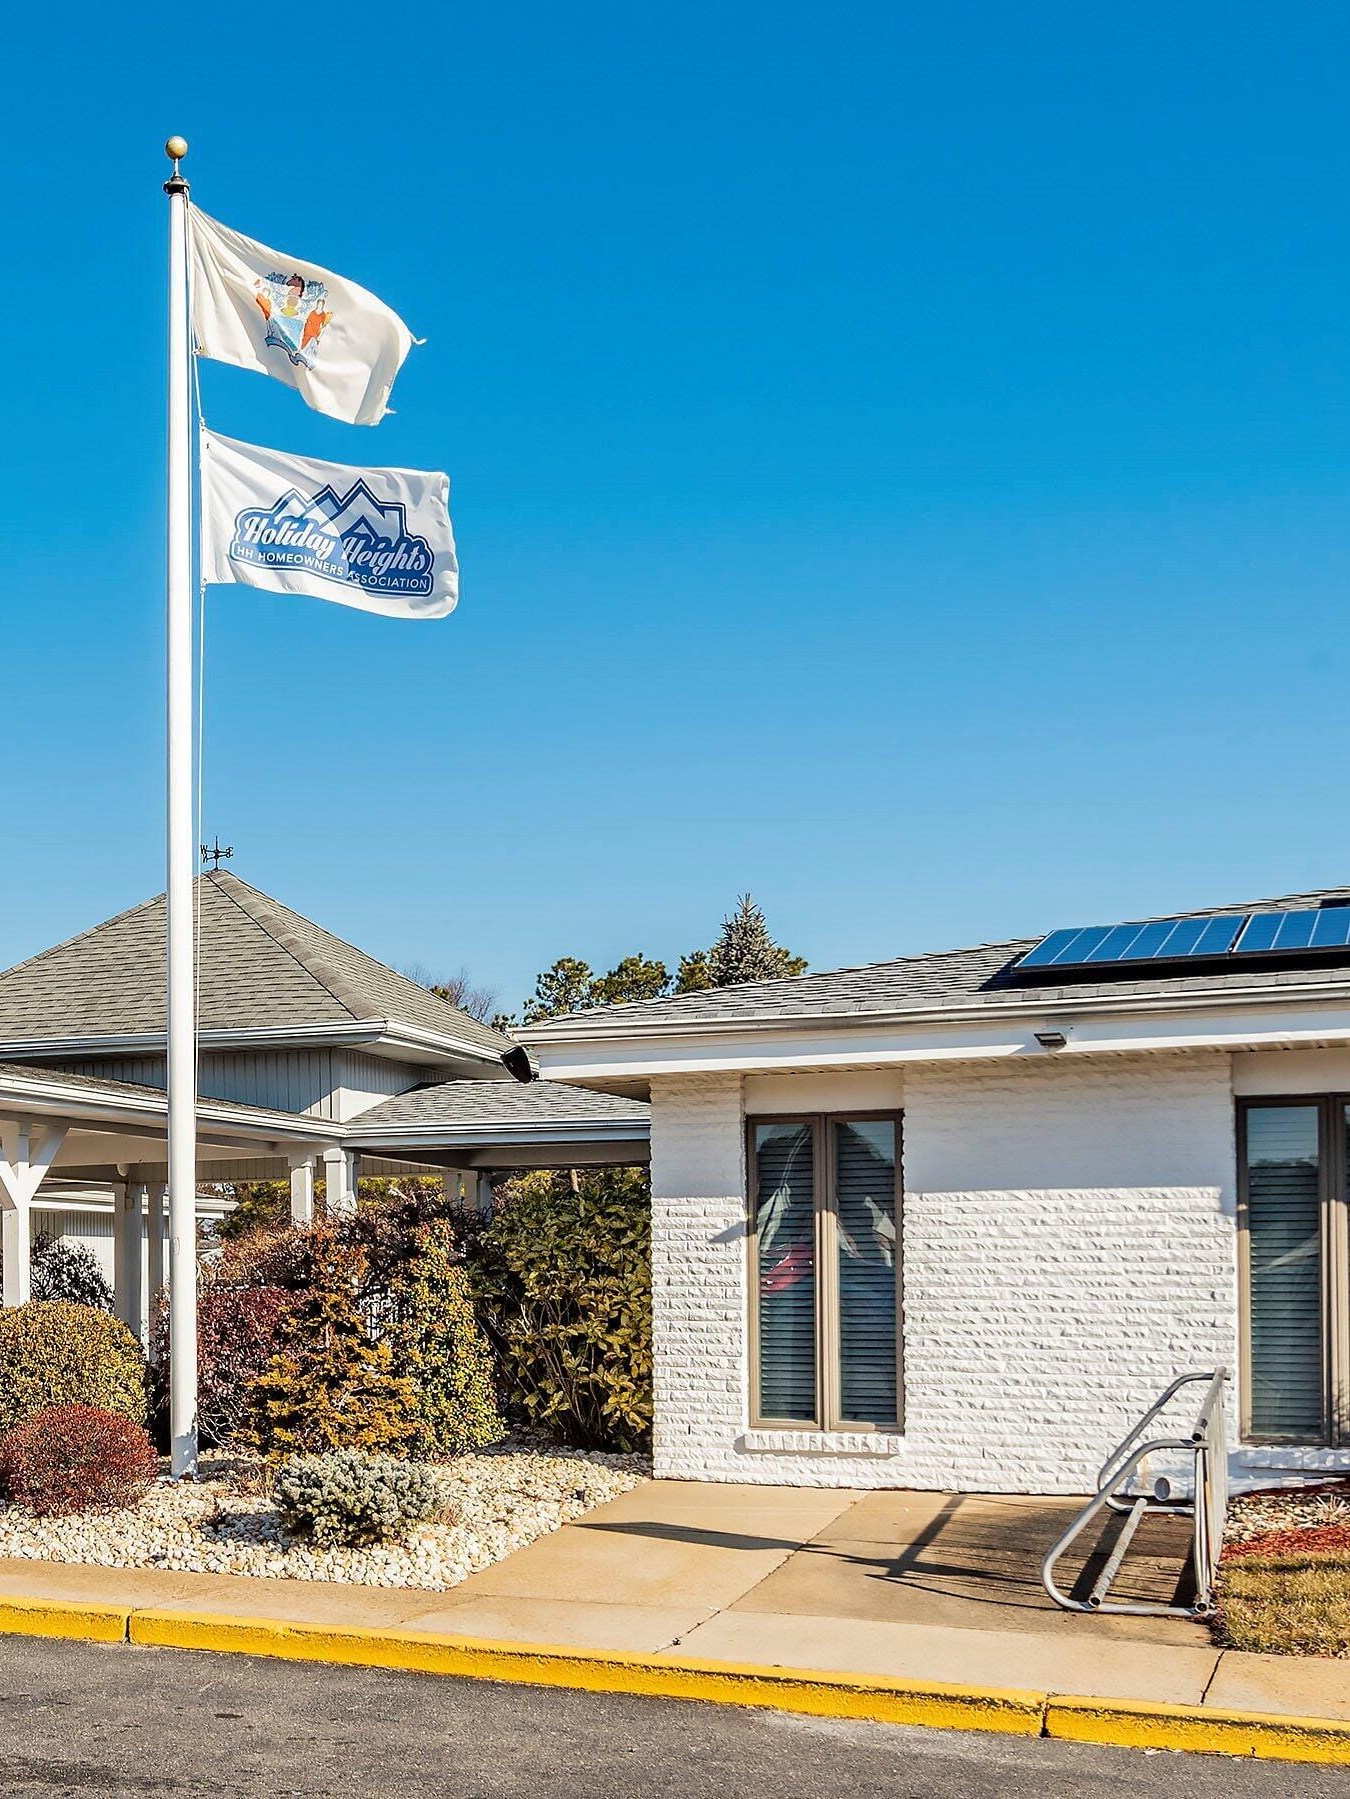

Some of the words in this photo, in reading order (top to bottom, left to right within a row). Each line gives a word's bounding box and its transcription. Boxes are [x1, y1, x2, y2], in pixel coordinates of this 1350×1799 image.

[236, 545, 254, 559] HH
[257, 551, 344, 577] HOMEOWNERS
[346, 570, 428, 589] ASSOCIATION
[244, 516, 336, 560] Holiday
[341, 536, 426, 576] Heights
